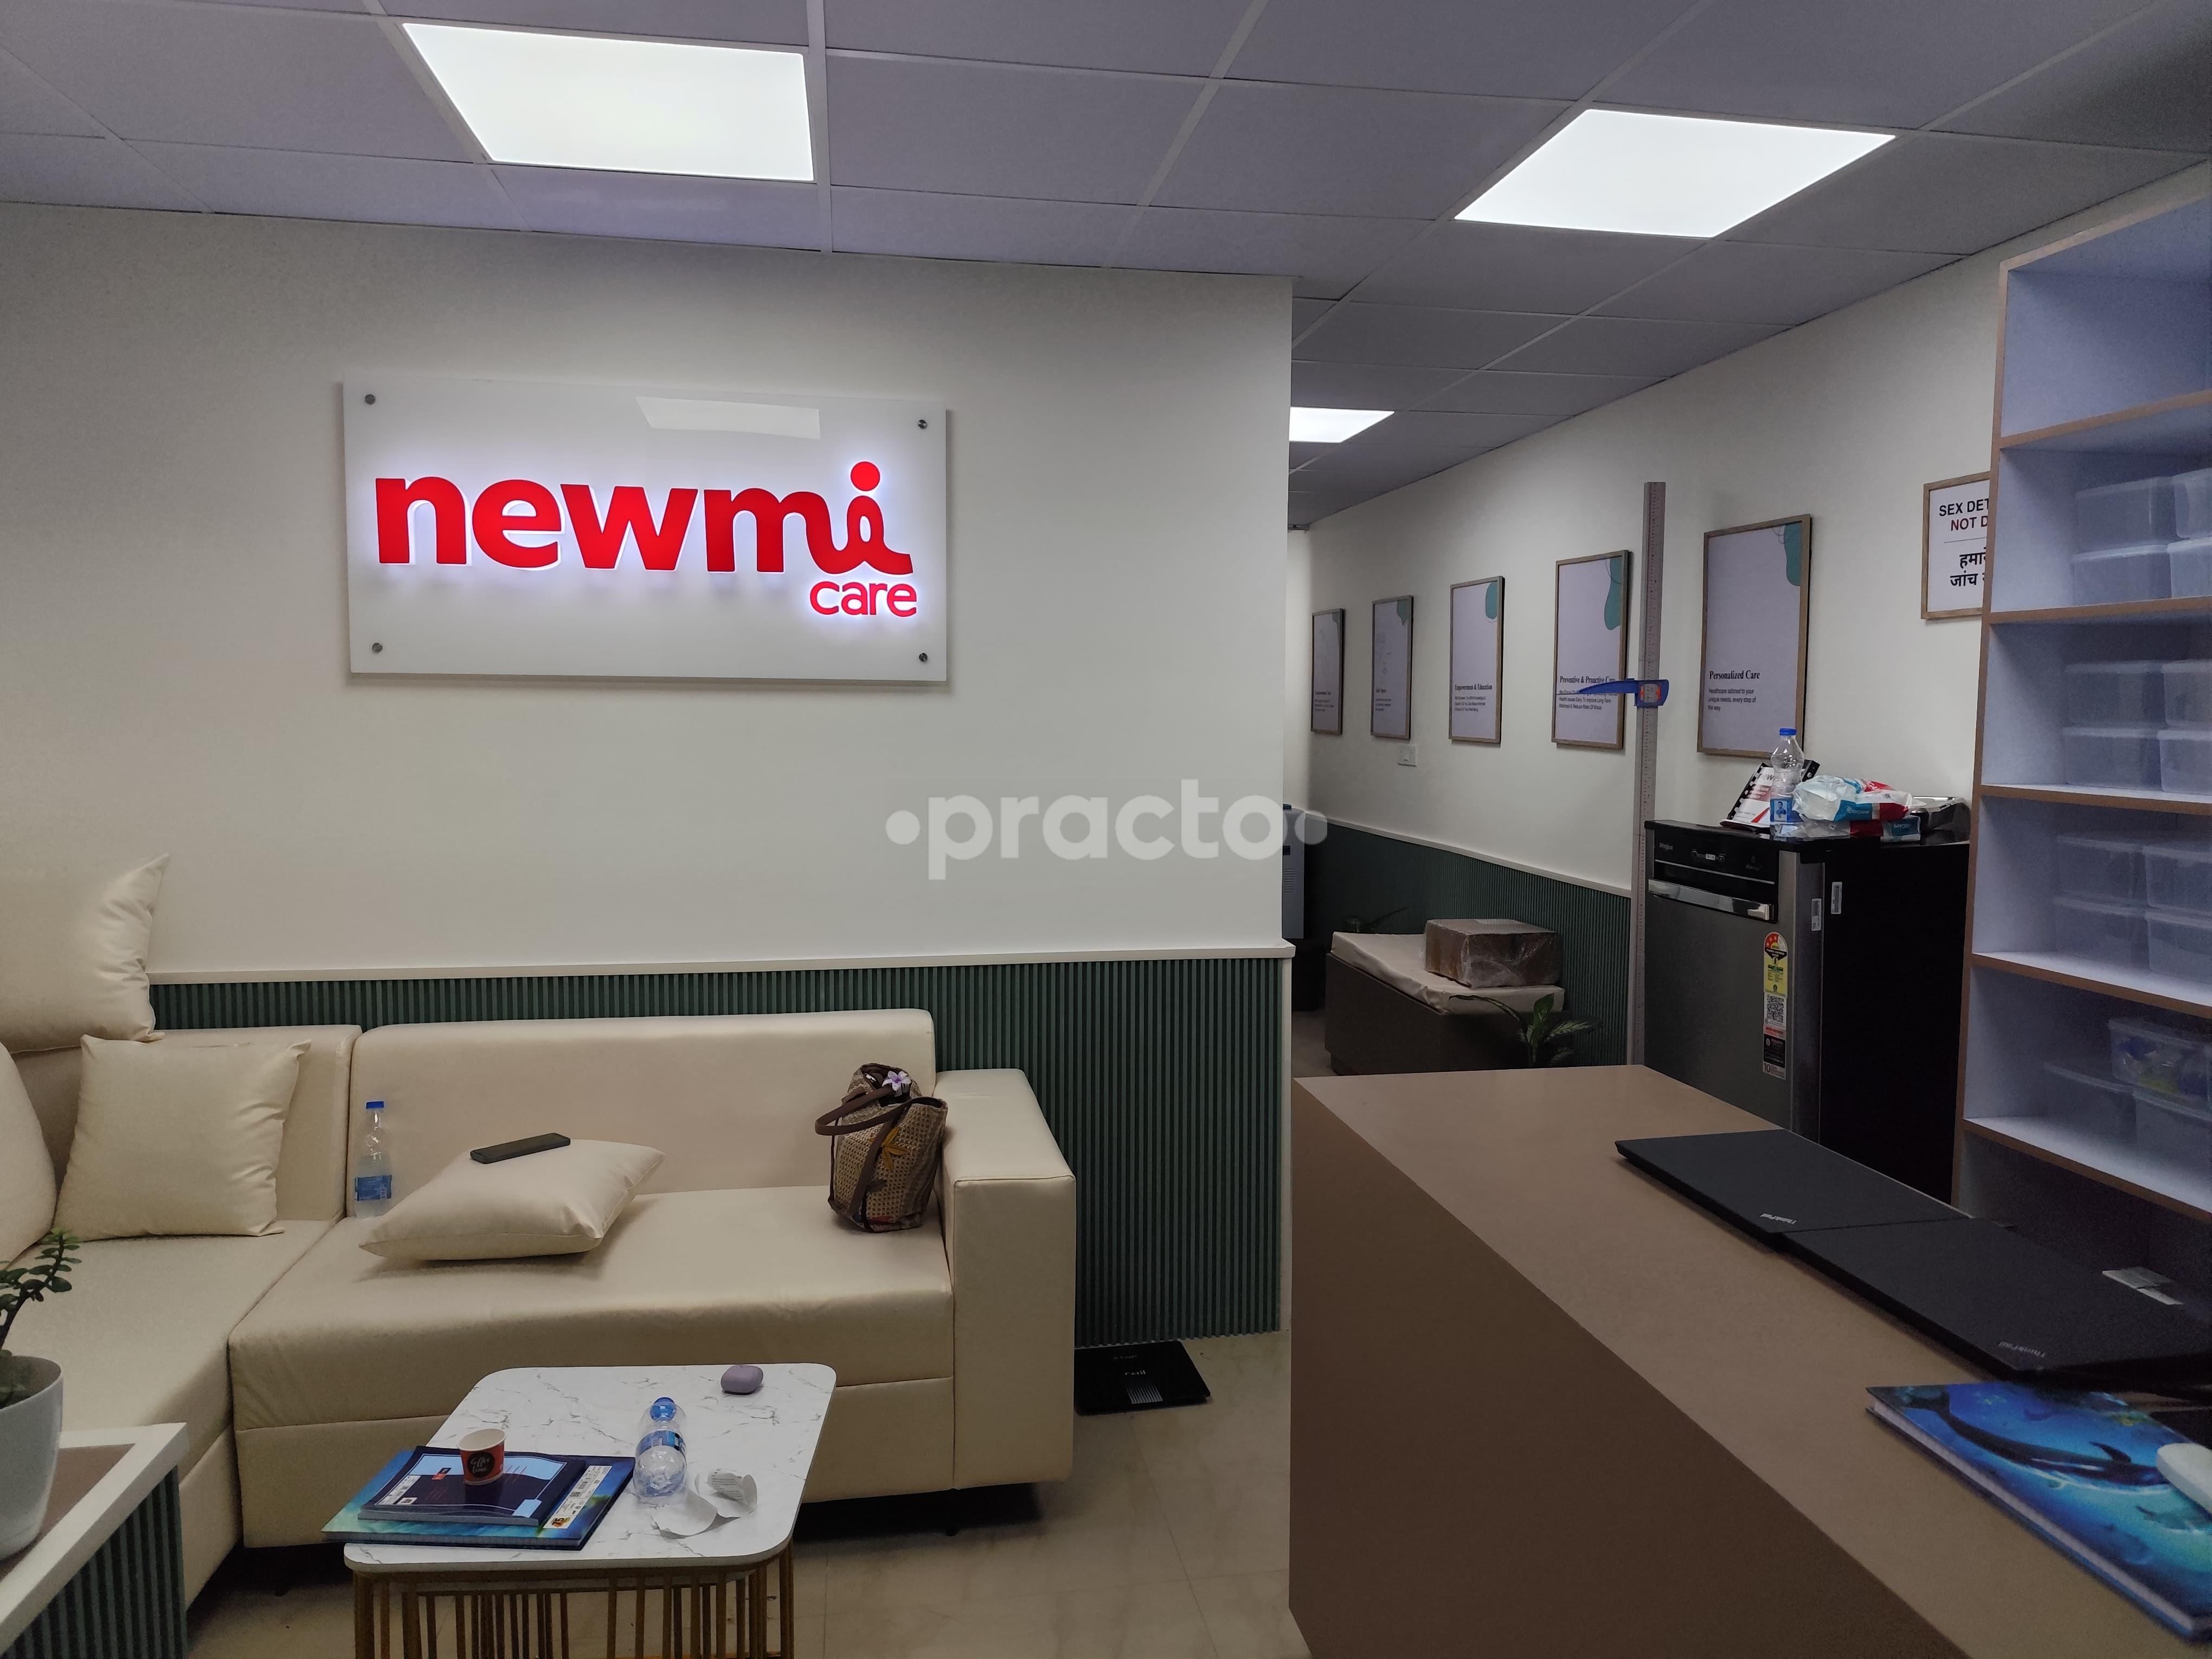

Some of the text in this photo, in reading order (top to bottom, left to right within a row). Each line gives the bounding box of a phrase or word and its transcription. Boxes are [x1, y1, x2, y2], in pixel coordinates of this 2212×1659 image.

[1939, 502, 1963, 517] SEX
[376, 461, 914, 575] newmi
[1951, 517, 1977, 531] NOT
[1950, 570, 1978, 587] जांच
[809, 581, 917, 617] care
[1709, 670, 1760, 679] Personalized Care
